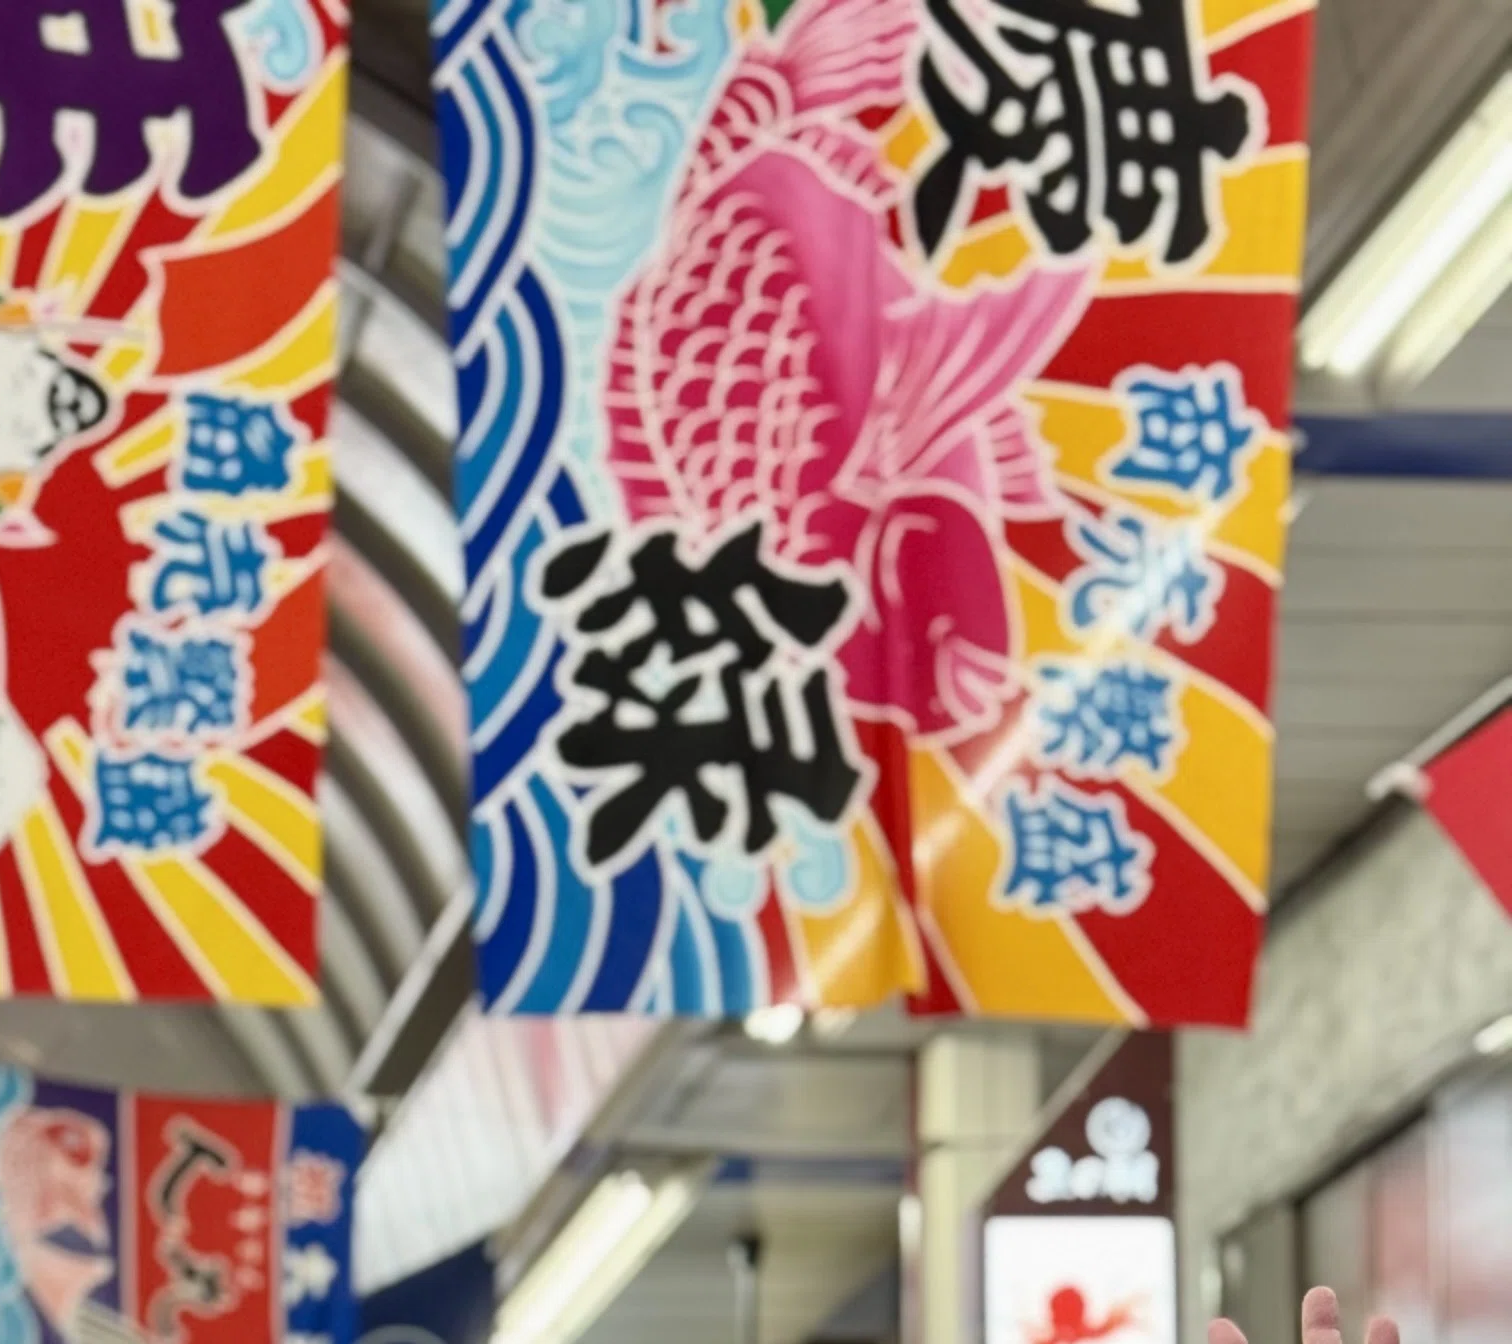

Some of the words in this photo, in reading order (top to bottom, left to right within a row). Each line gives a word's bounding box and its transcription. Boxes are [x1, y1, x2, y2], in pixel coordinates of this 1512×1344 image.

[93, 391, 296, 852] 商売繁盛
[1002, 376, 1255, 909] 商売繁盛
